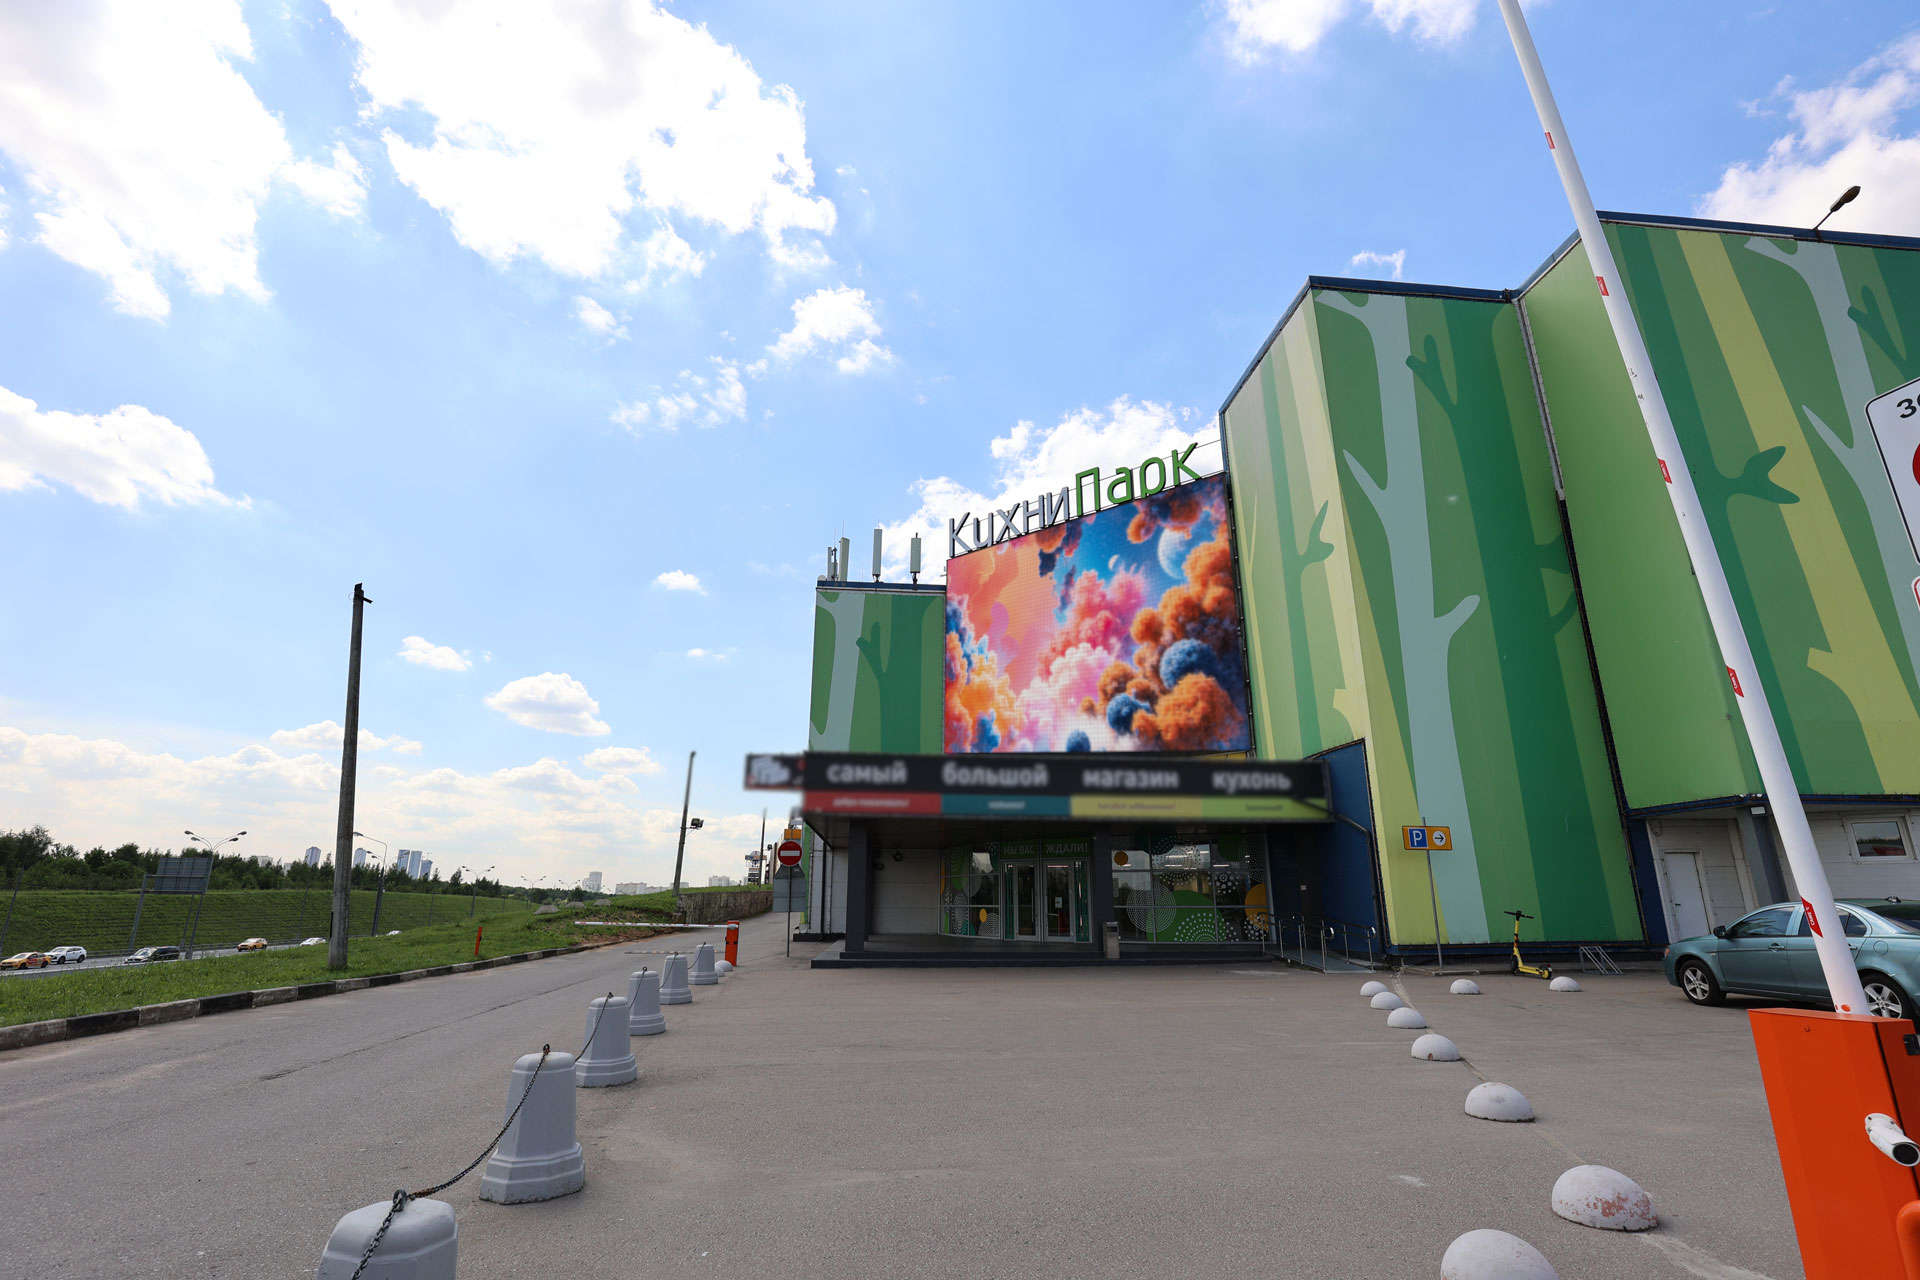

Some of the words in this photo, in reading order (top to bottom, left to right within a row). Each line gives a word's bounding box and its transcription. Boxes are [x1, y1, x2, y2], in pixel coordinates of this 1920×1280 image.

[827, 762, 907, 784] самый
[941, 761, 1050, 786] большой
[1081, 767, 1180, 789] магазин
[1211, 769, 1292, 794] кухонь
